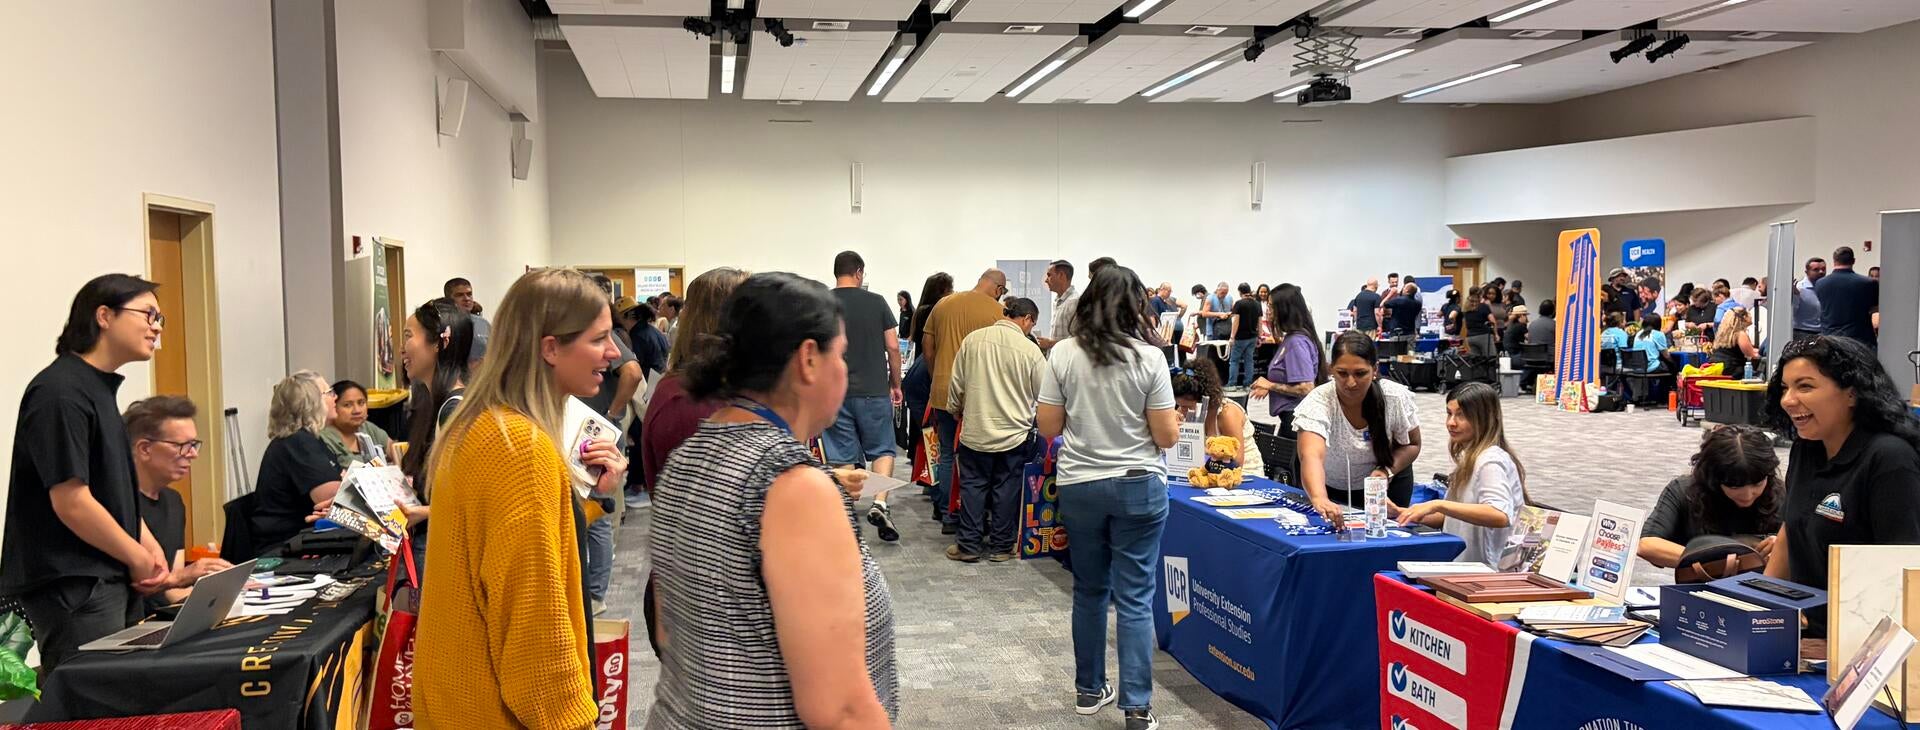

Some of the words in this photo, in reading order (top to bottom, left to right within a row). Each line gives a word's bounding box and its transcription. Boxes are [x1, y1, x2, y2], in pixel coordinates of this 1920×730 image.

[1599, 529, 1621, 541] Choose
[1602, 519, 1616, 530] Why
[1166, 562, 1188, 604] UCR
[1192, 578, 1221, 609] University
[1220, 595, 1252, 625] Extension
[1193, 597, 1228, 631] Professional
[1227, 618, 1252, 645] Studies
[1752, 618, 1784, 626] PuroStone
[1409, 626, 1451, 661] KITCHEN
[1208, 643, 1255, 681] extension.ucr.edu
[1411, 680, 1436, 708] BATH
